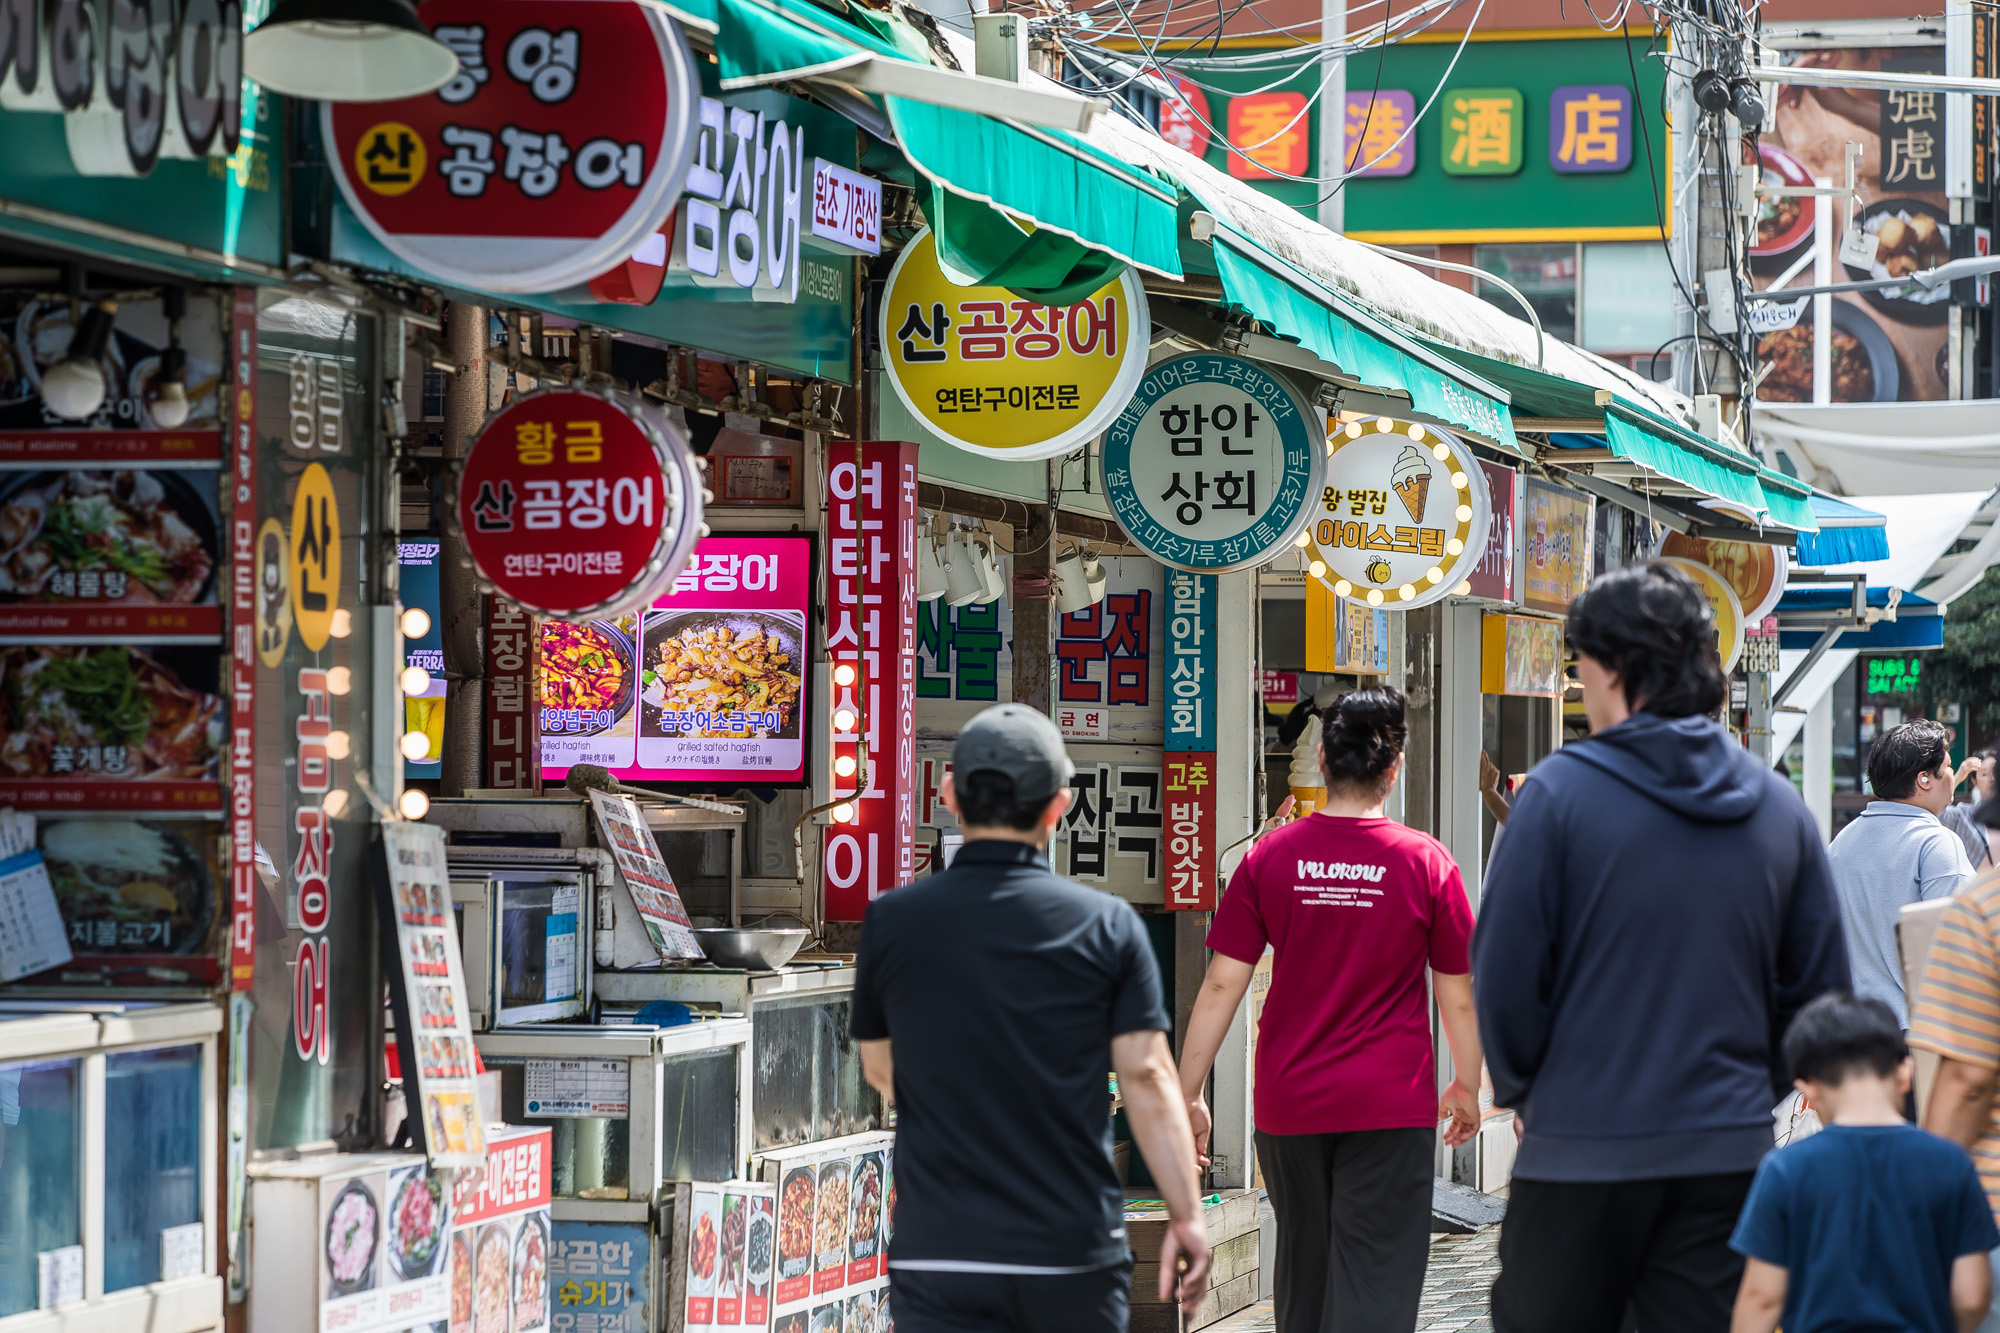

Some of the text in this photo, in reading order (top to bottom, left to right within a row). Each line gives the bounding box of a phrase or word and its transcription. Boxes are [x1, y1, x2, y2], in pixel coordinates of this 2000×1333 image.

[1235, 94, 1621, 173] 香港酒店
[363, 125, 644, 197] 산 곰장어
[815, 168, 878, 243] 원조 기장산
[896, 296, 1117, 363] 산 곰장어
[935, 384, 1080, 414] 연탄구이전문
[1111, 360, 1294, 446] 3대를 이어온 고추방앗간
[515, 420, 604, 466] 황금
[1159, 402, 1260, 457] 함안
[470, 475, 654, 533] 산 곰장어
[1160, 470, 1257, 526] 상회
[1321, 486, 1388, 516] 왕 벌집
[299, 494, 331, 612] 산
[1316, 518, 1446, 558] 아이스크림
[51, 571, 127, 598] 해물탕
[504, 551, 623, 577] 연탄구이전문
[406, 655, 446, 671] TERRA
[1170, 573, 1206, 739] 함안상회
[562, 741, 591, 752] hagfish
[660, 711, 781, 732] 곰장어소금구이
[51, 746, 127, 772] 꽃게탕
[677, 742, 761, 753] grilled salted hagfish
[1166, 762, 1209, 795] 고추
[1064, 766, 1164, 882] 잡곡
[1170, 801, 1204, 904] 방앗간
